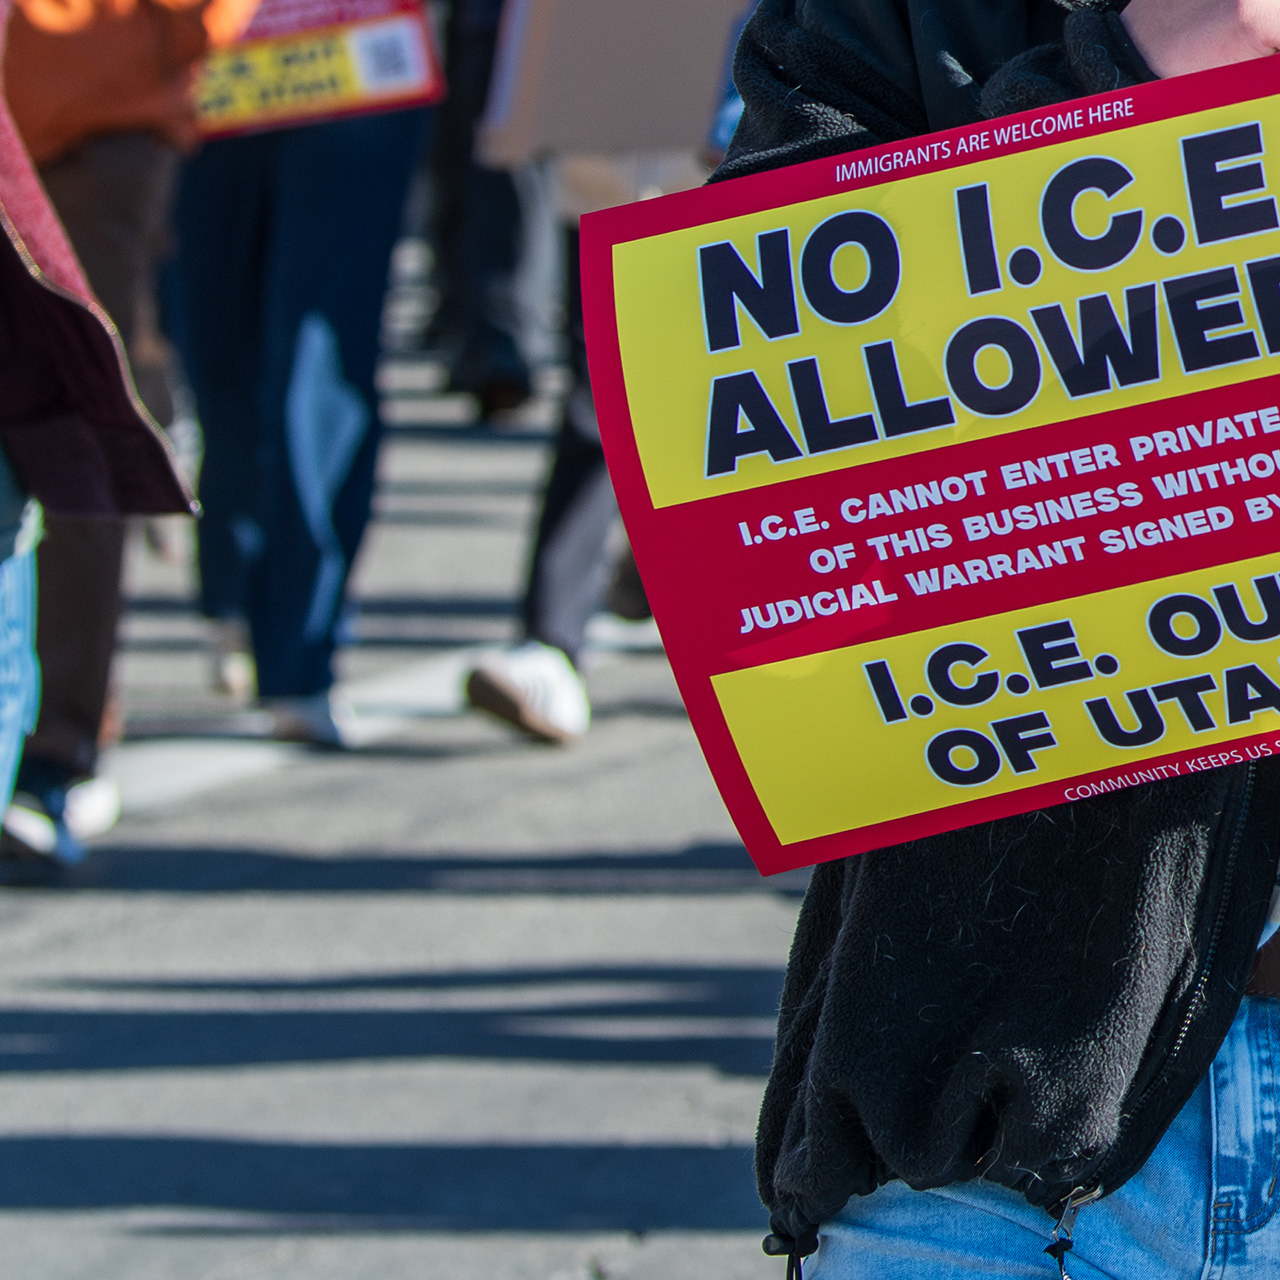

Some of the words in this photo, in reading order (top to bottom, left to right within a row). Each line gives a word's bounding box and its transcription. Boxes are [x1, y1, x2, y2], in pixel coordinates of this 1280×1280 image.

[835, 141, 952, 183] IMMIGRANTS
[956, 131, 991, 156] ARE
[993, 109, 1084, 146] WELCOME
[1087, 97, 1135, 125] HERE
[698, 209, 900, 354] NO
[738, 507, 830, 546] I.C.E.
[840, 470, 988, 524] CANNOT
[1000, 443, 1121, 490] ENTER
[809, 543, 856, 574] OF
[866, 523, 953, 561] THIS
[961, 482, 1144, 542] BUSINESS
[740, 580, 899, 634] JUDICIAL
[904, 535, 1086, 597] WARRANT
[1099, 505, 1235, 554] SIGNED
[862, 617, 1121, 724] I.C.E.
[924, 710, 1059, 789] OF
[1064, 762, 1182, 802] COMMUNITY
[1185, 749, 1244, 774] KEEPS
[1245, 743, 1273, 760] US
